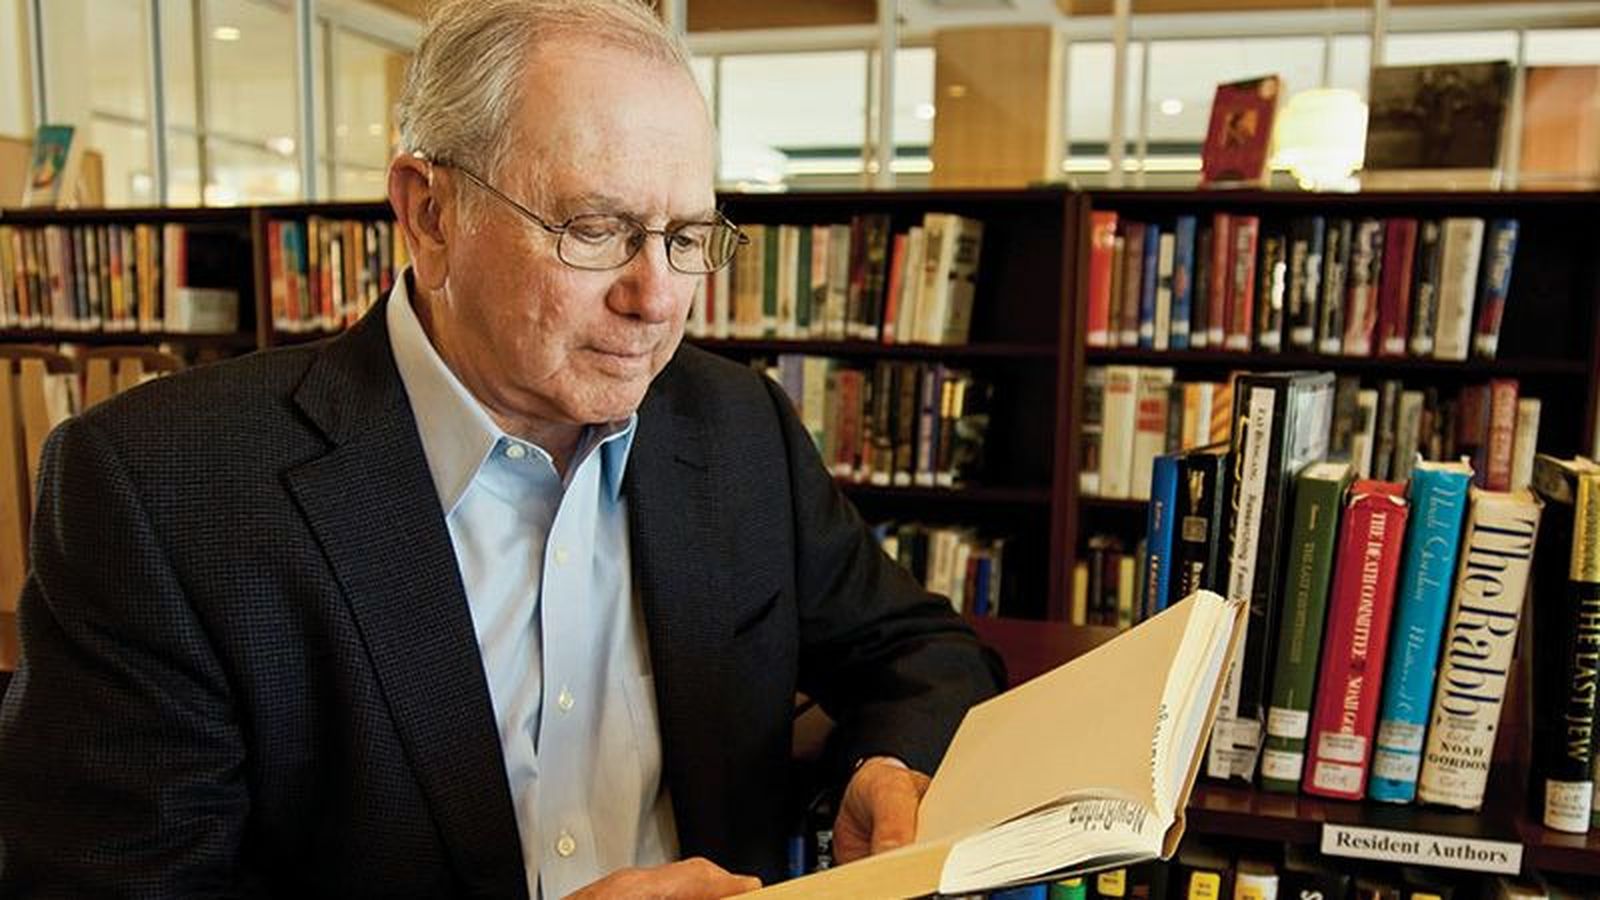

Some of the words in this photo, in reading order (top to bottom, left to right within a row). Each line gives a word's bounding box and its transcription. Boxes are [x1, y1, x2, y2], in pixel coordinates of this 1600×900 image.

[1463, 516, 1535, 598] The
[1436, 603, 1518, 732] Rabb
[1570, 653, 1599, 710] LAST
[1427, 752, 1488, 772] GORDON
[1441, 741, 1485, 758] NOAH
[1564, 714, 1593, 764] JEW
[1336, 831, 1420, 855] Resident
[1427, 842, 1508, 863] Authors
